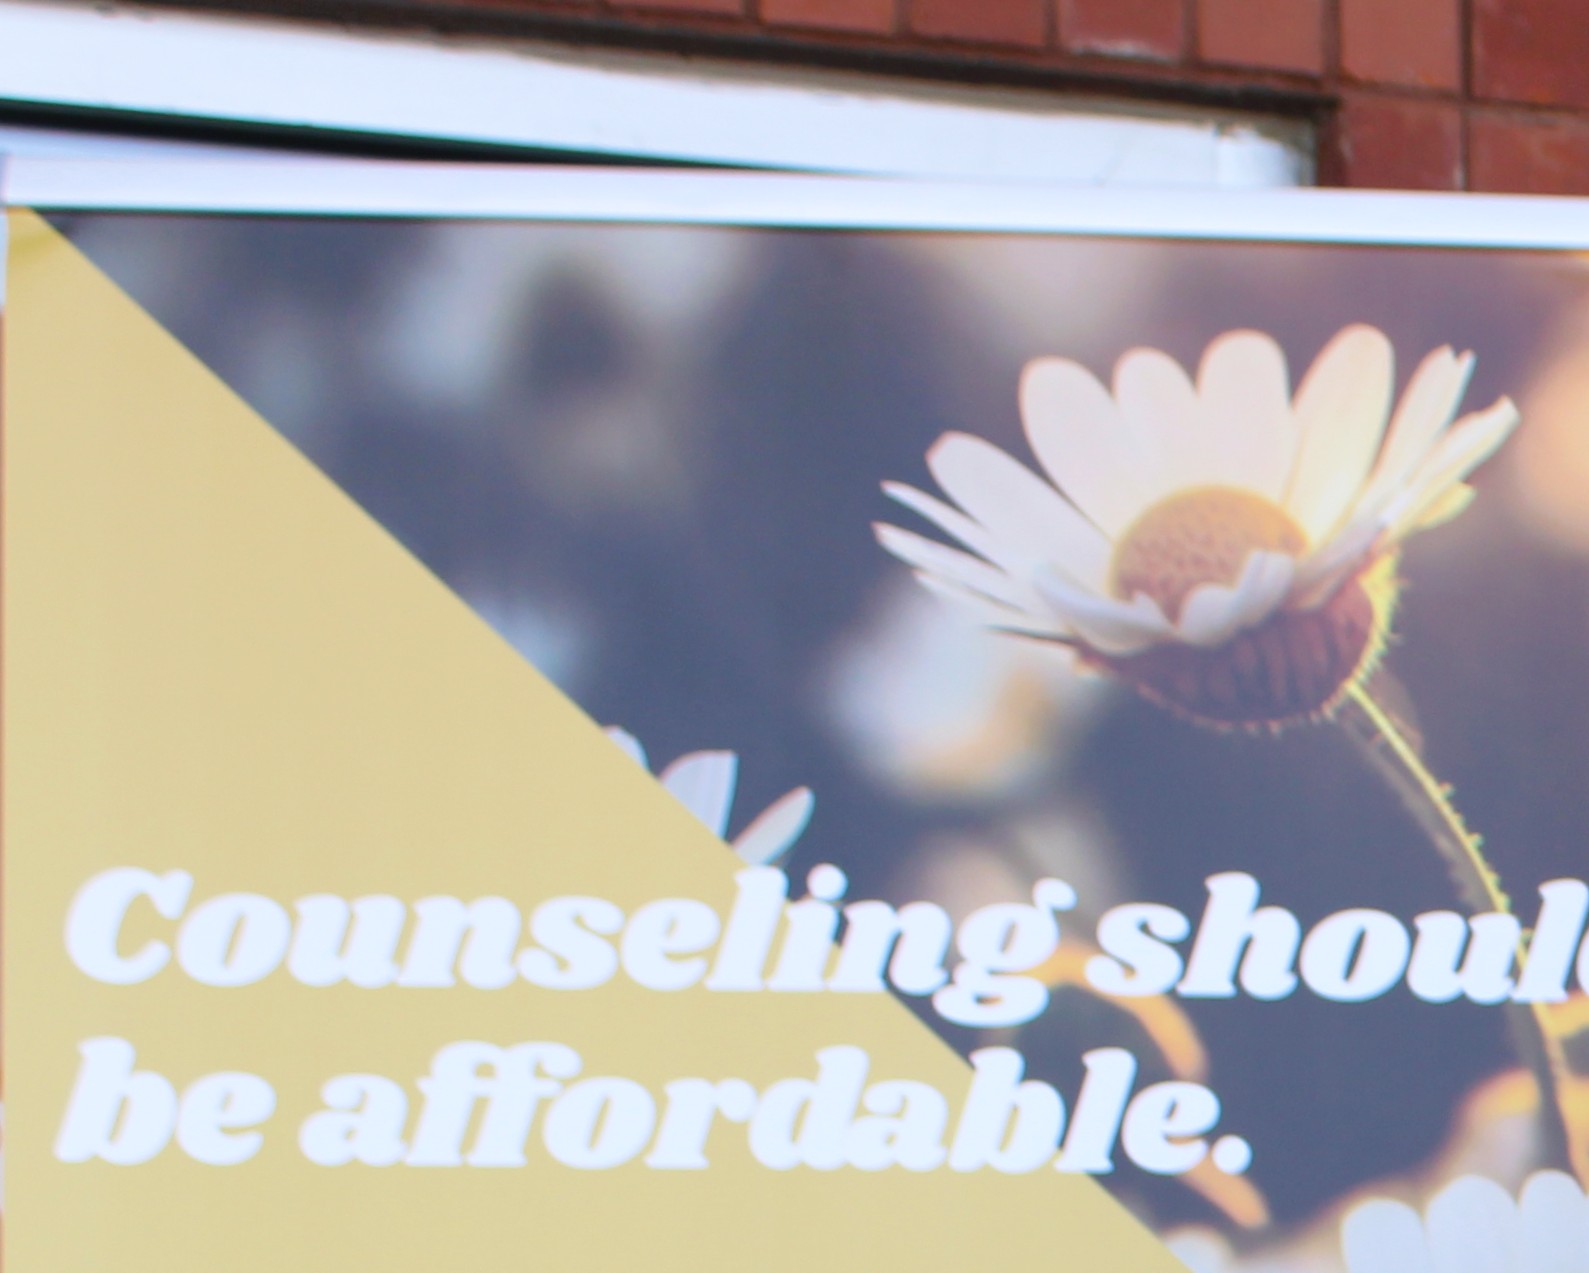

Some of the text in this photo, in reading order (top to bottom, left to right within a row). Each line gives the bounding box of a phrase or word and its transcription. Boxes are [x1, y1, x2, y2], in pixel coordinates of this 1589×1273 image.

[64, 862, 1076, 1028] Counseling
[53, 1036, 1252, 1175] be affordable.
